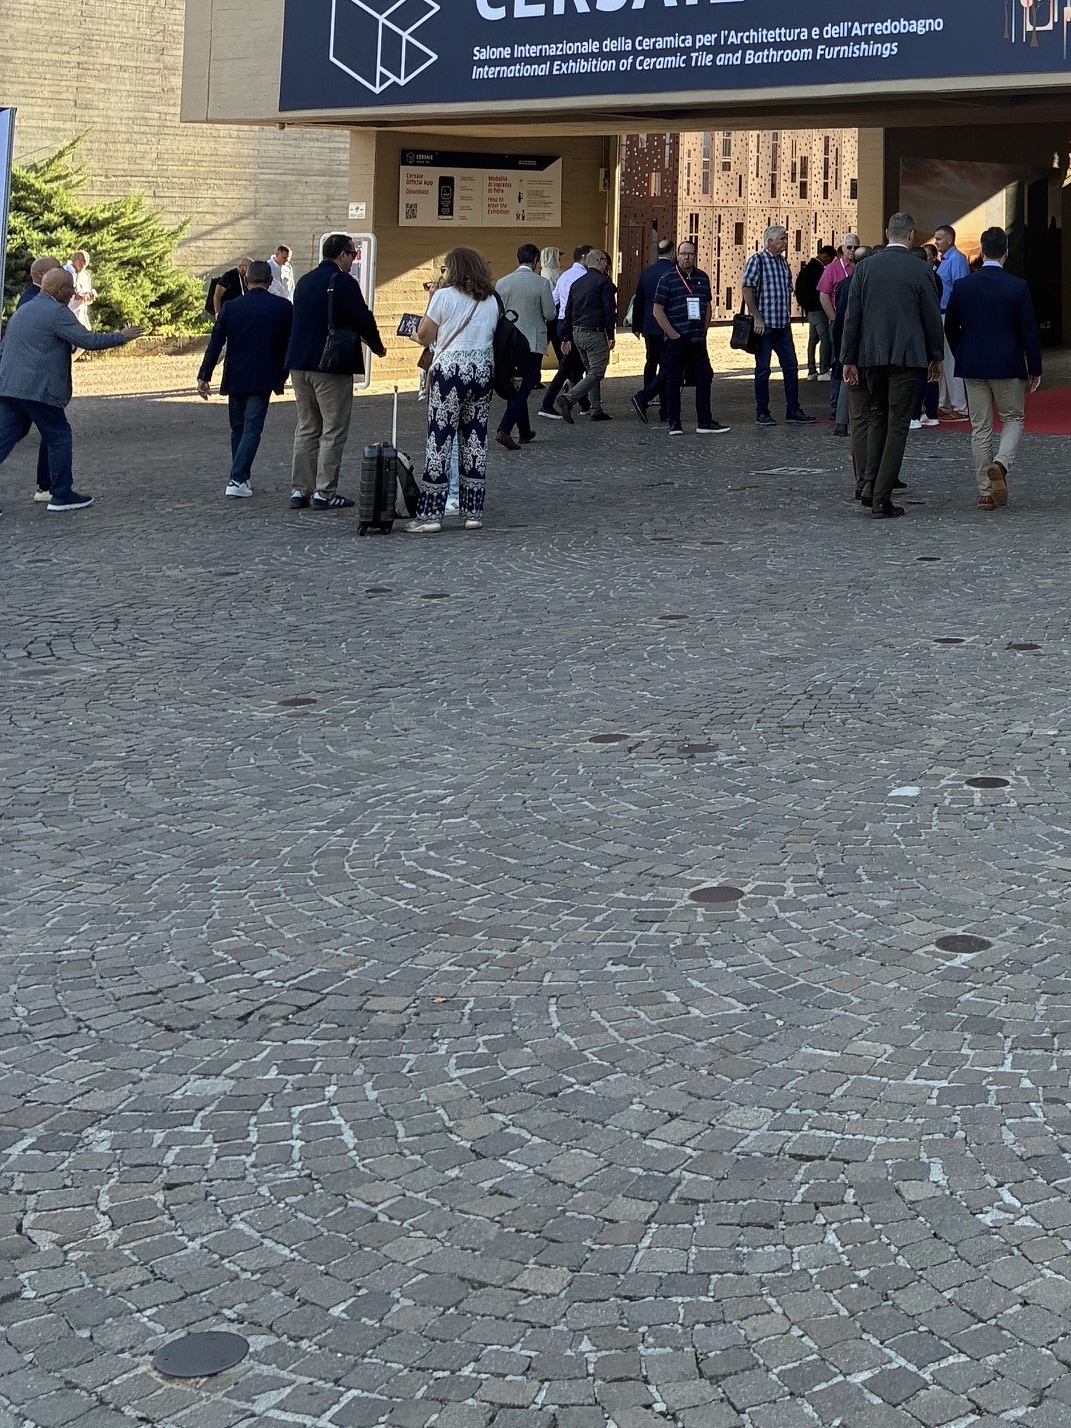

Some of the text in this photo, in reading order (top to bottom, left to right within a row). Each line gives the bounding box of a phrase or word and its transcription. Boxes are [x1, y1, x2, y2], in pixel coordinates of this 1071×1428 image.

[471, 40, 899, 80] International Exhibition of Ceramic Tile and Bathroom Furnishings
[472, 17, 944, 61] Salone Internazionale della Ceramica per l'Architettura e dell'Arredobagno
